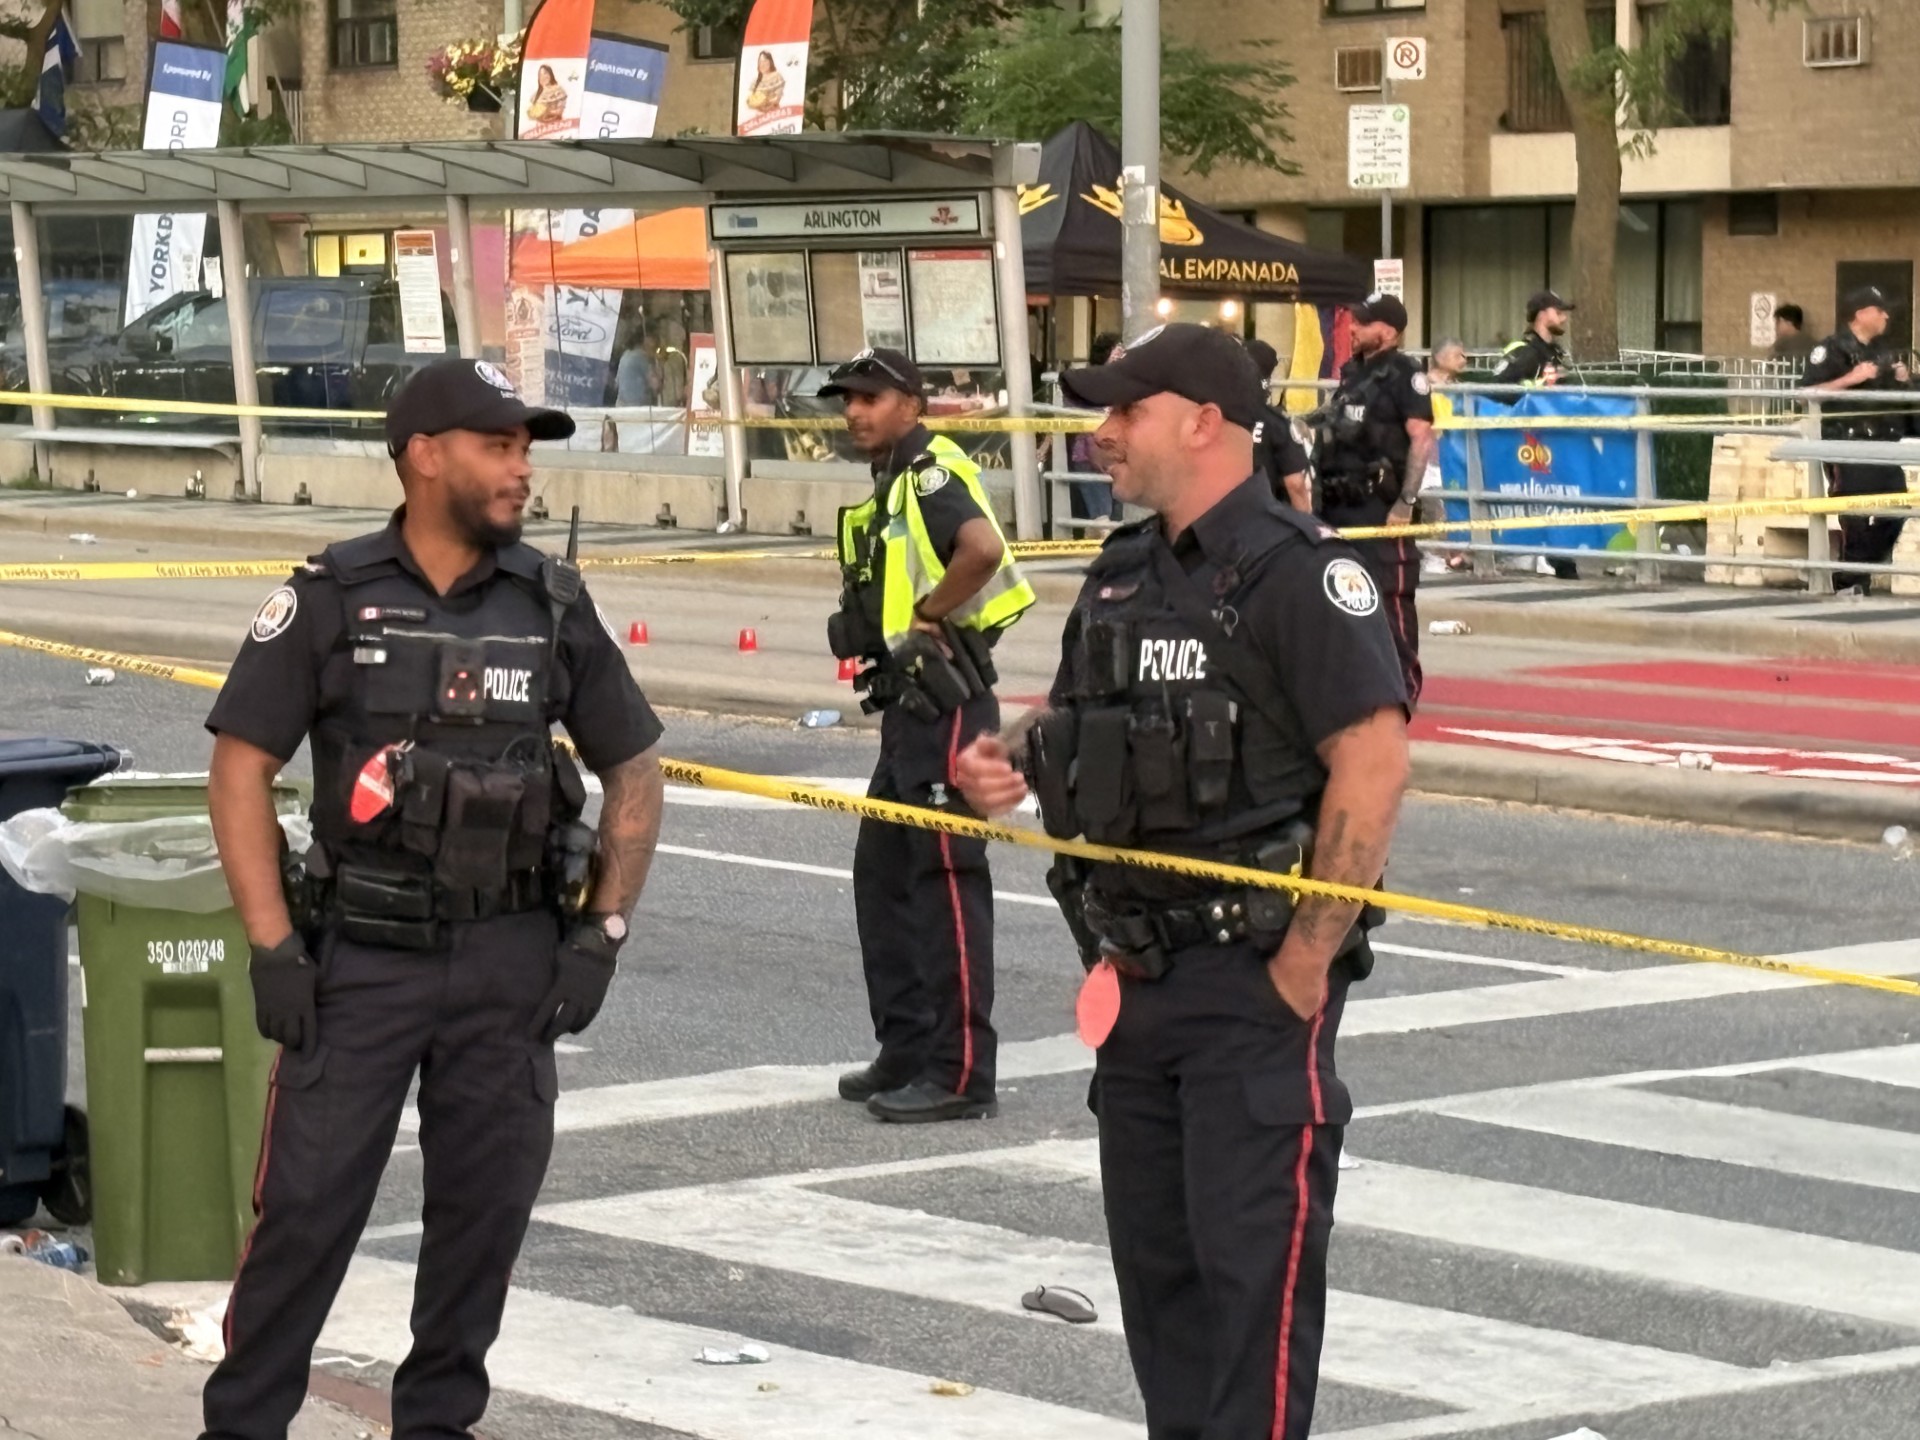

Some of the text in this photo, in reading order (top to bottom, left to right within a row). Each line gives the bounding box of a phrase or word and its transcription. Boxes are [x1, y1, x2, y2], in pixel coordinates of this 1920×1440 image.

[163, 63, 202, 78] Sponsored
[590, 59, 636, 77] Sponsored
[804, 209, 881, 228] ARLINGTON
[149, 213, 174, 293] YORKD
[1159, 257, 1299, 284] AL EMPANADA
[1139, 639, 1207, 682] POLICE
[484, 667, 533, 702] POLICE
[178, 939, 225, 963] 020248
